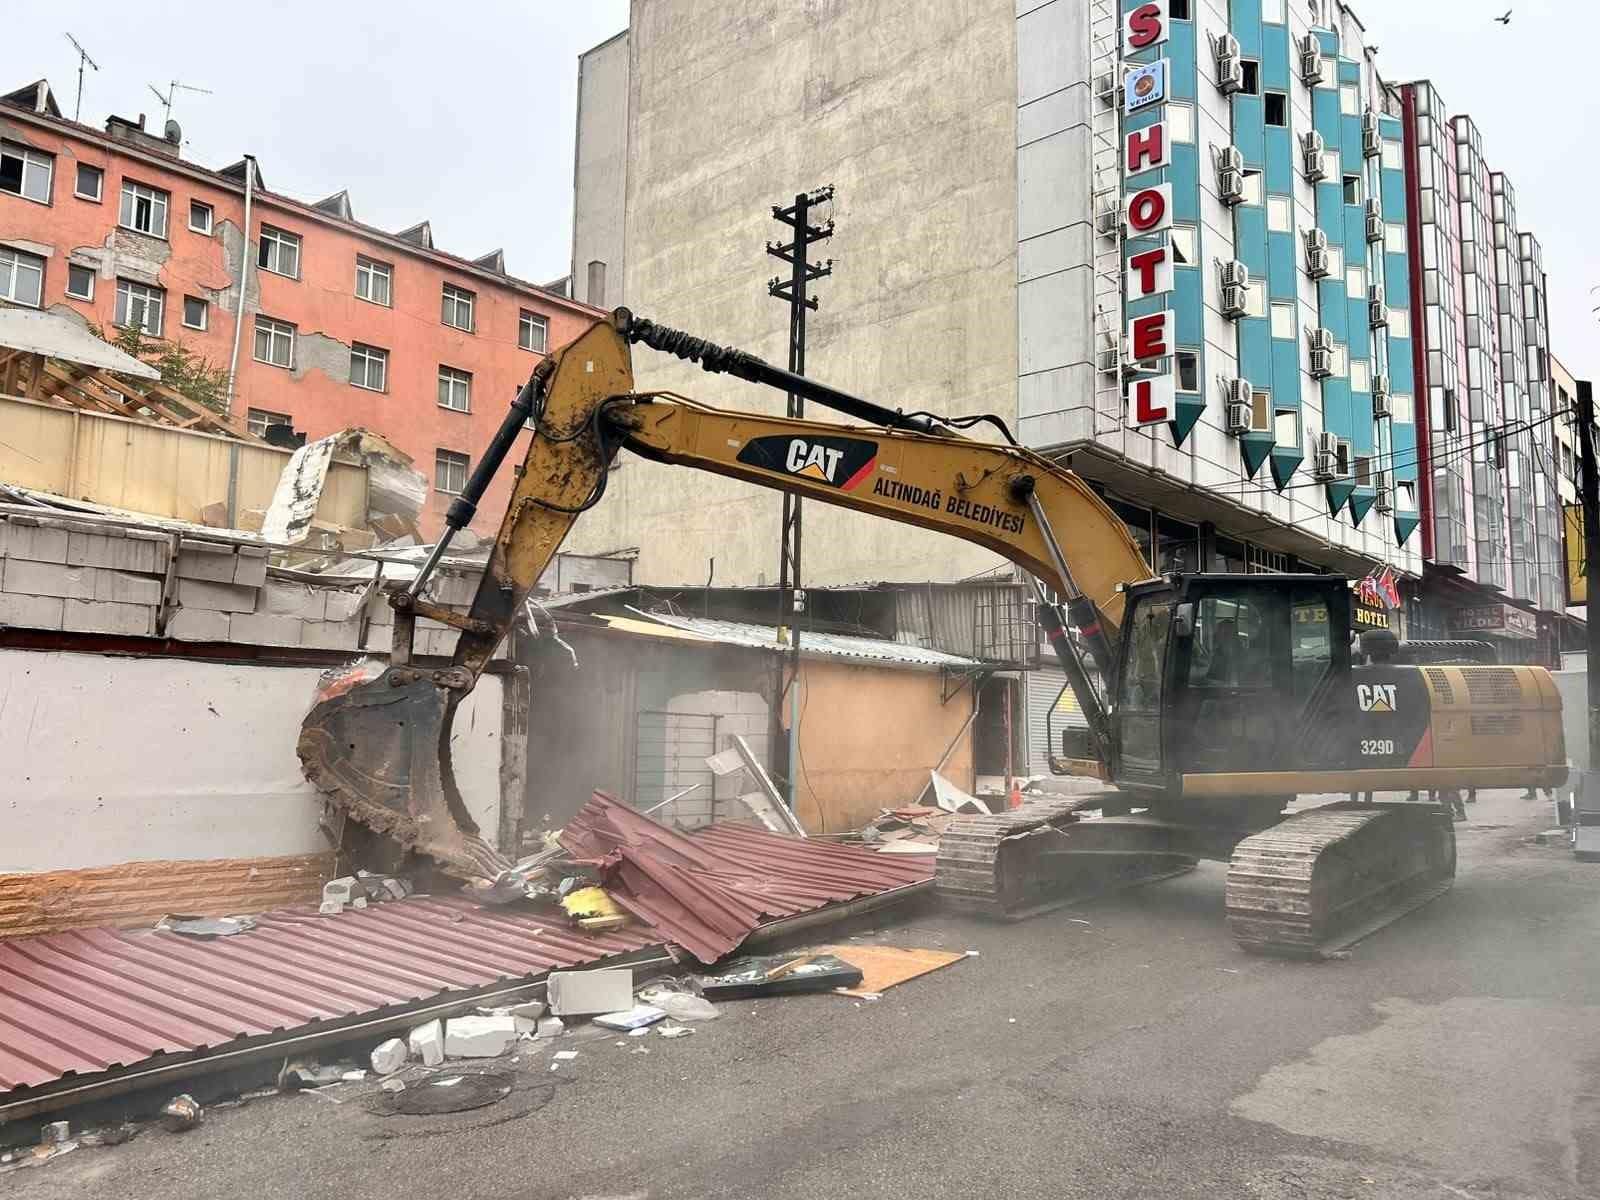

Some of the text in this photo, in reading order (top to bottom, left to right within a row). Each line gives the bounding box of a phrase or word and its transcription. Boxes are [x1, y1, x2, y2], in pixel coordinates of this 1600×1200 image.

[1128, 3, 1161, 49] S
[1127, 123, 1167, 424] HOTEL
[785, 439, 844, 483] CAT
[873, 477, 1026, 536] ALTINDAĞ BELEDİYESİ
[1356, 608, 1389, 628] HOTEL
[1356, 684, 1397, 712] CAT
[1361, 740, 1393, 754] 329D
